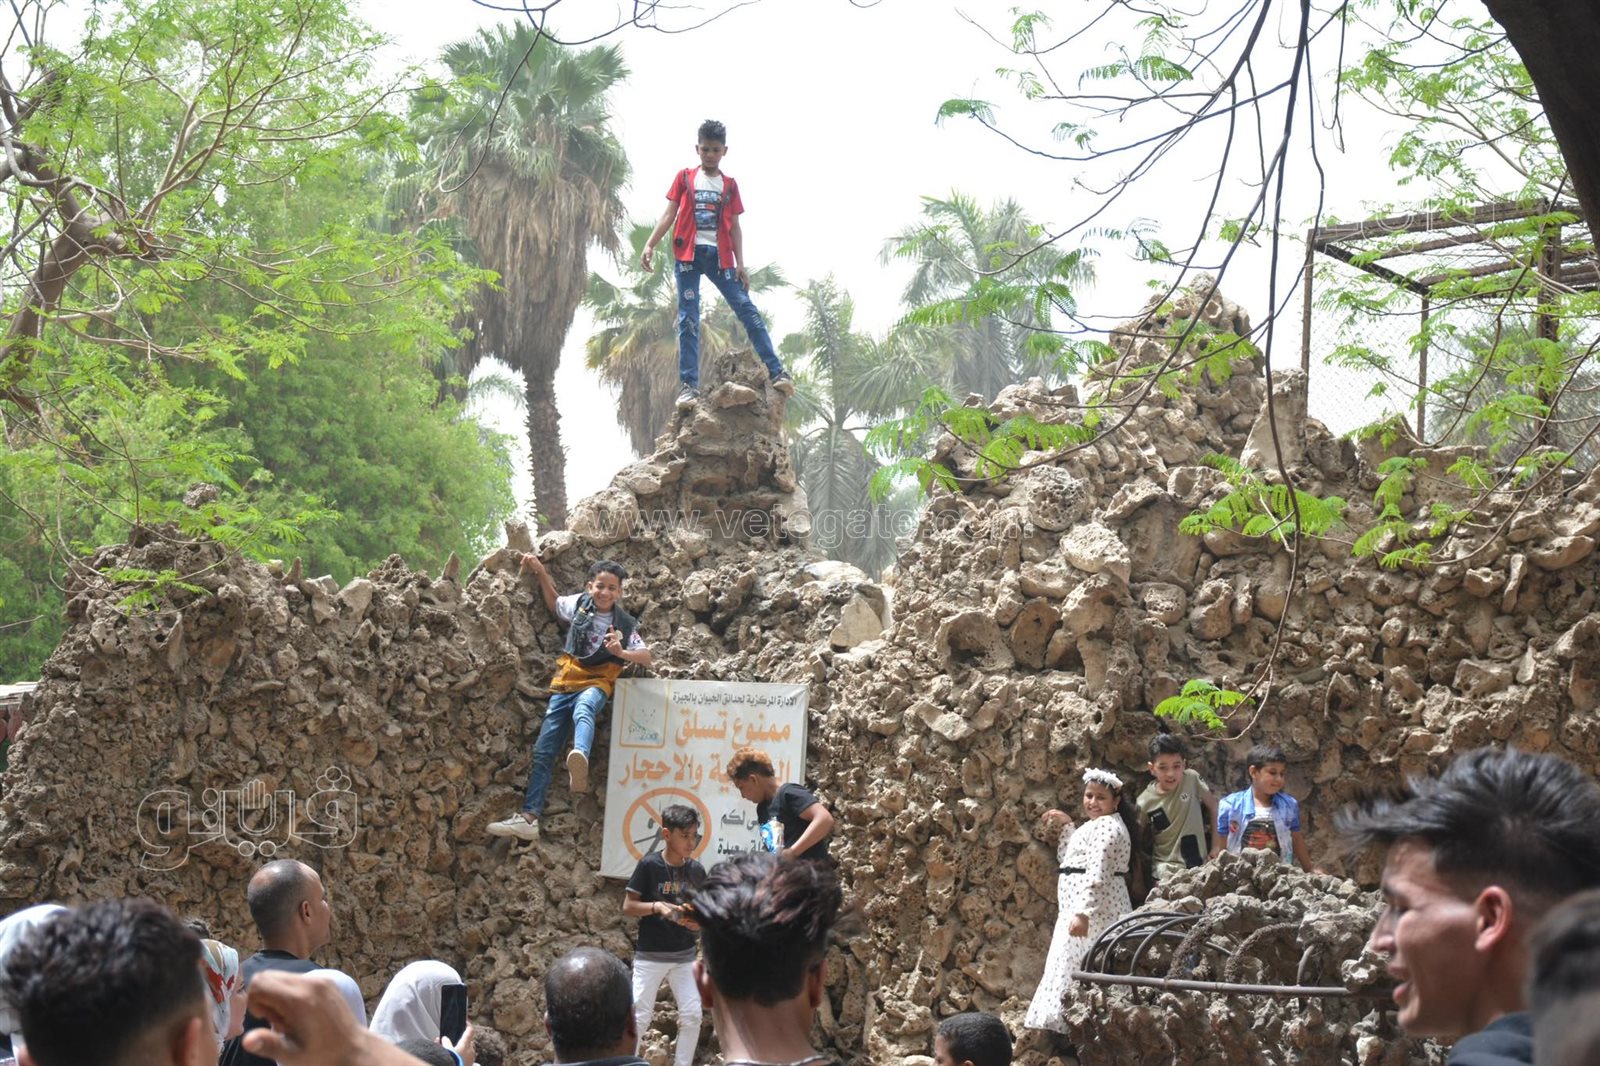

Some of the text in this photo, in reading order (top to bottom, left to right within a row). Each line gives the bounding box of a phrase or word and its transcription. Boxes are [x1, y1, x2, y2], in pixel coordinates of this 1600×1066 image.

[672, 691, 697, 705] بالجيزة
[697, 692, 722, 705] الحيوان
[722, 693, 745, 706] لحدائق
[746, 694, 776, 708] المركزية
[675, 708, 791, 750] ممنوع تسلق
[618, 751, 704, 790] والاحجار
[720, 808, 746, 829] لكم
[717, 837, 748, 853] سعيدة
